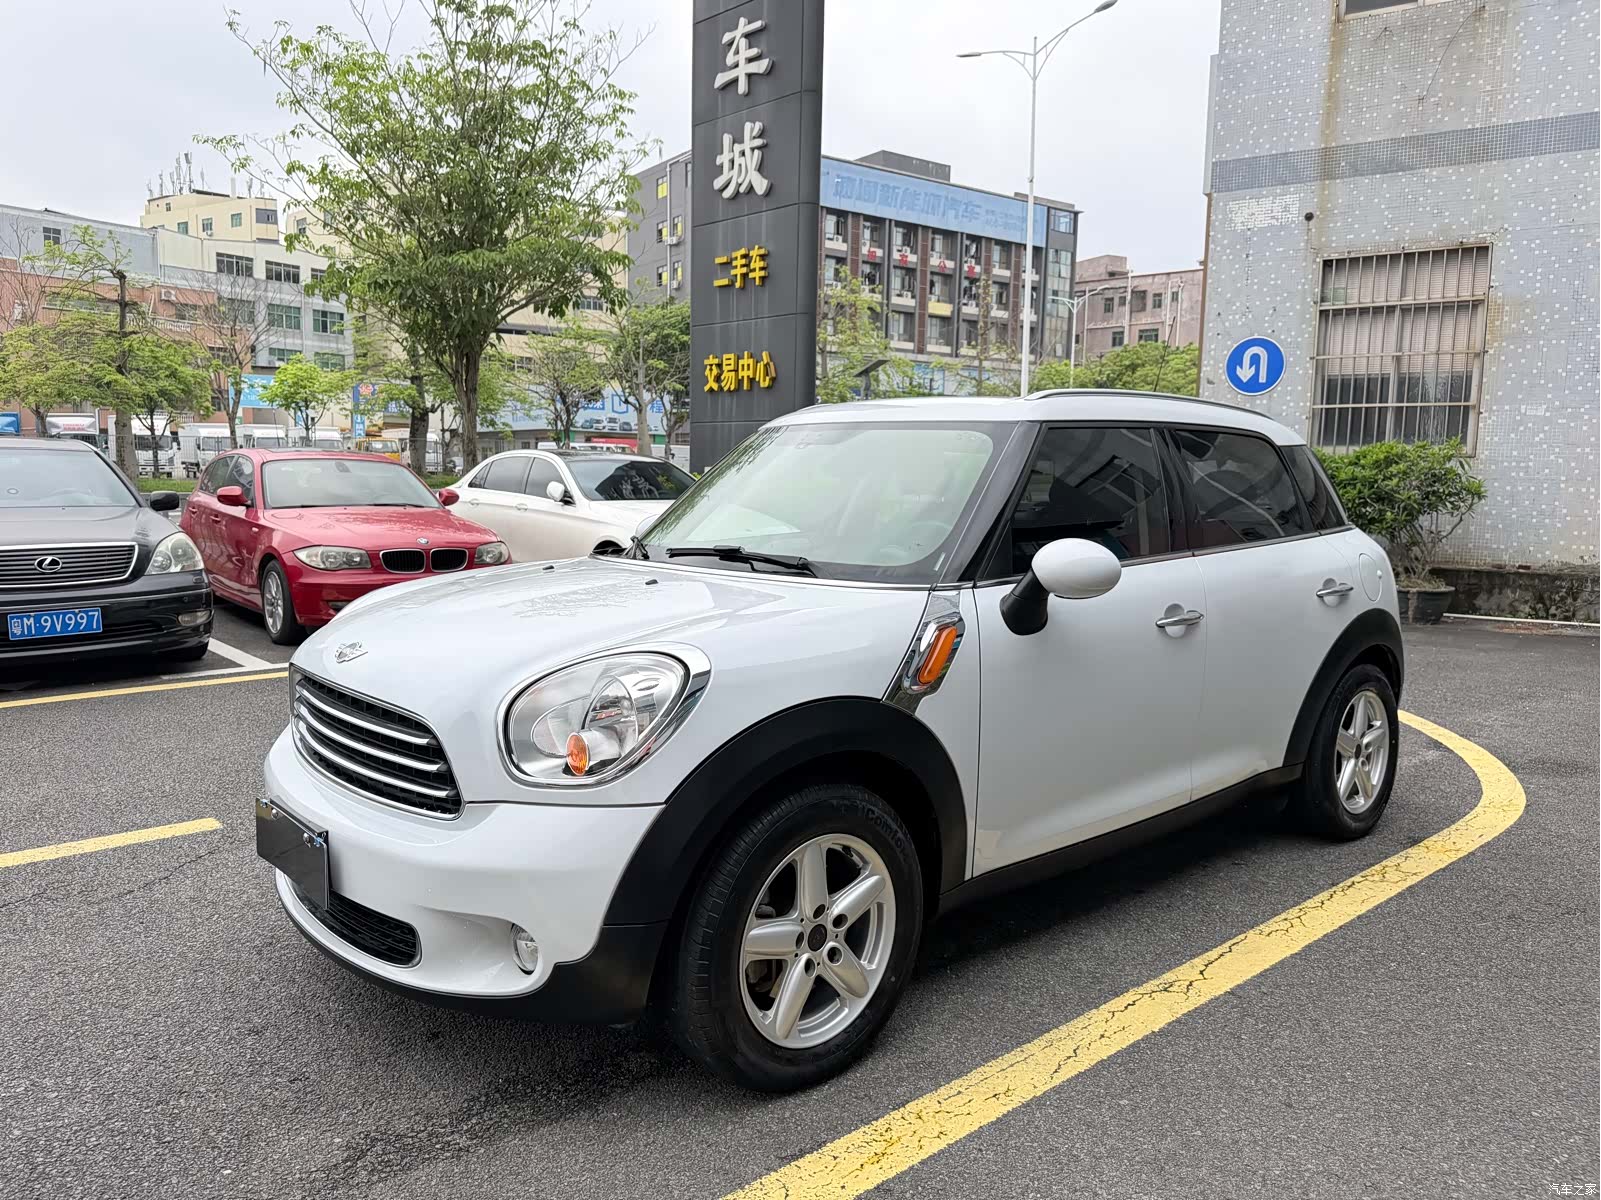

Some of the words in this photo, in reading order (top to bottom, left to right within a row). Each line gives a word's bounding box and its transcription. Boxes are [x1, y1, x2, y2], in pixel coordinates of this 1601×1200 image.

[713, 244, 769, 290] 二手车
[703, 351, 776, 392] 交易中心
